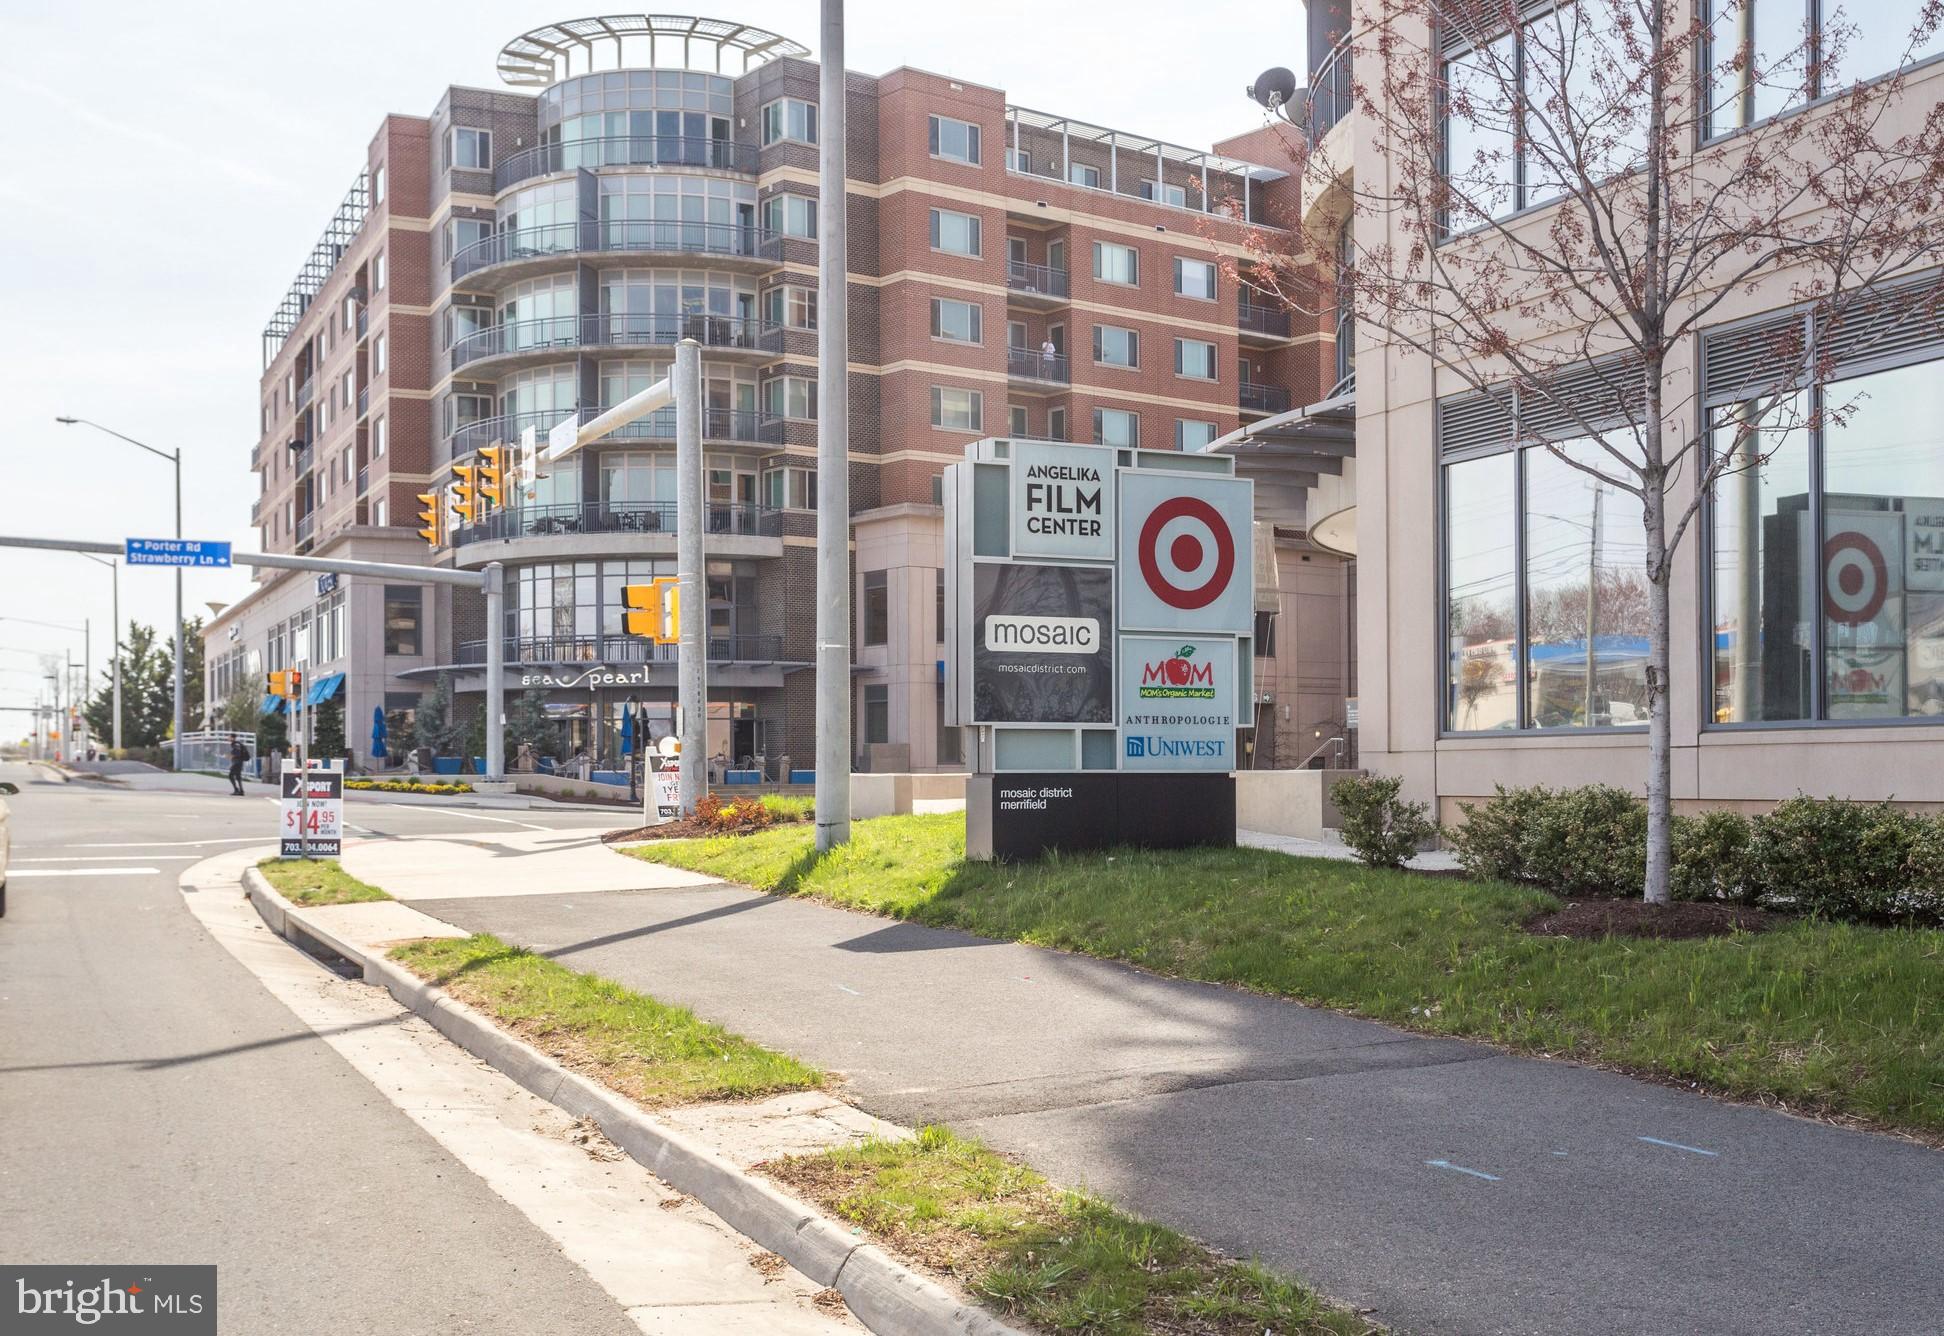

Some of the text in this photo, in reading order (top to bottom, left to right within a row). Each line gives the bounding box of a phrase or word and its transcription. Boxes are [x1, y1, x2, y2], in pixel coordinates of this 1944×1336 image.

[1026, 464, 1101, 482] ANGELIKA
[1026, 483, 1101, 515] FILM
[1027, 517, 1101, 536] CENTER
[144, 541, 202, 552] Porter Rd
[130, 552, 214, 565] Strawberry Ln
[994, 622, 1092, 646] mosaic
[998, 663, 1087, 674] mosaicdistrict.com
[1142, 658, 1213, 686] MOM
[521, 665, 650, 691] sea pearl
[1162, 689, 1187, 698] Organic
[1188, 689, 1214, 697] Market
[1126, 715, 1230, 725] ANTHROPOLOGIE
[1147, 736, 1225, 757] UNIWEST
[1000, 787, 1073, 798] mosaic district
[1000, 799, 1047, 810] merrifield
